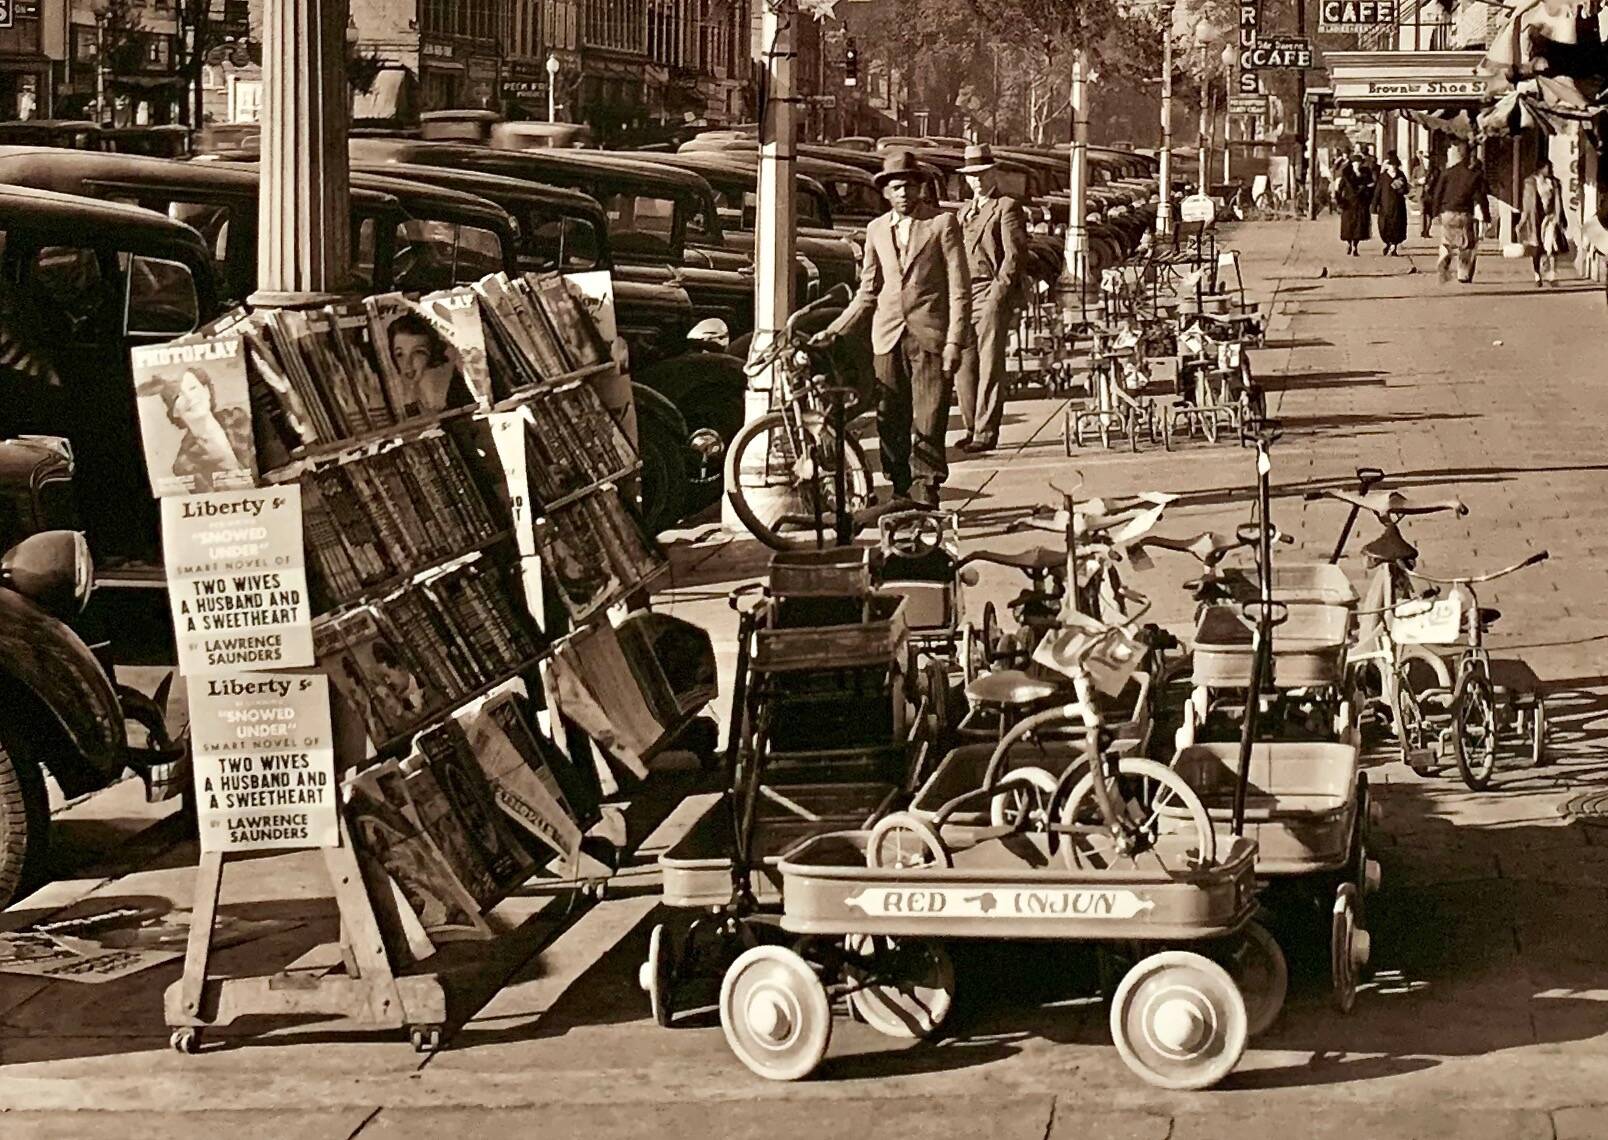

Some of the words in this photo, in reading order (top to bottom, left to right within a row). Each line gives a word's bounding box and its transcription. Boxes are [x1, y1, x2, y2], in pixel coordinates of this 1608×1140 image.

[1325, 2, 1392, 22] CAFE
[1241, 0, 1257, 91] RUGS
[1253, 50, 1310, 66] CAFE
[1427, 82, 1467, 92] Shoe
[133, 341, 239, 368] PHOTOPLAY
[182, 499, 264, 518] Liberty
[226, 558, 267, 570] NOVEL
[275, 555, 290, 565] OF
[193, 578, 226, 596] TWO
[233, 573, 281, 592] WIVES
[181, 600, 190, 615] A
[197, 593, 263, 613] HUSBAND
[269, 590, 300, 607] AND
[187, 617, 196, 632] A
[203, 607, 298, 630] SWEETHEART
[205, 634, 282, 652] LAWRENCE
[208, 648, 282, 665] SAUNDERS
[208, 679, 292, 697] Liberty
[203, 740, 245, 751] SMART
[252, 737, 297, 748] NOVEL
[303, 736, 320, 746] OF
[218, 757, 252, 774] TWO
[260, 753, 310, 771] WIVES
[204, 776, 214, 792] A
[221, 772, 290, 791] HUSBAND
[296, 771, 327, 787] AND
[209, 794, 219, 810] A
[226, 788, 324, 808] SWEETHEART
[227, 814, 308, 831] LAWRENCE
[230, 827, 308, 844] SAUNDERS
[883, 891, 947, 913] RED
[1013, 892, 1116, 914] INJUN
